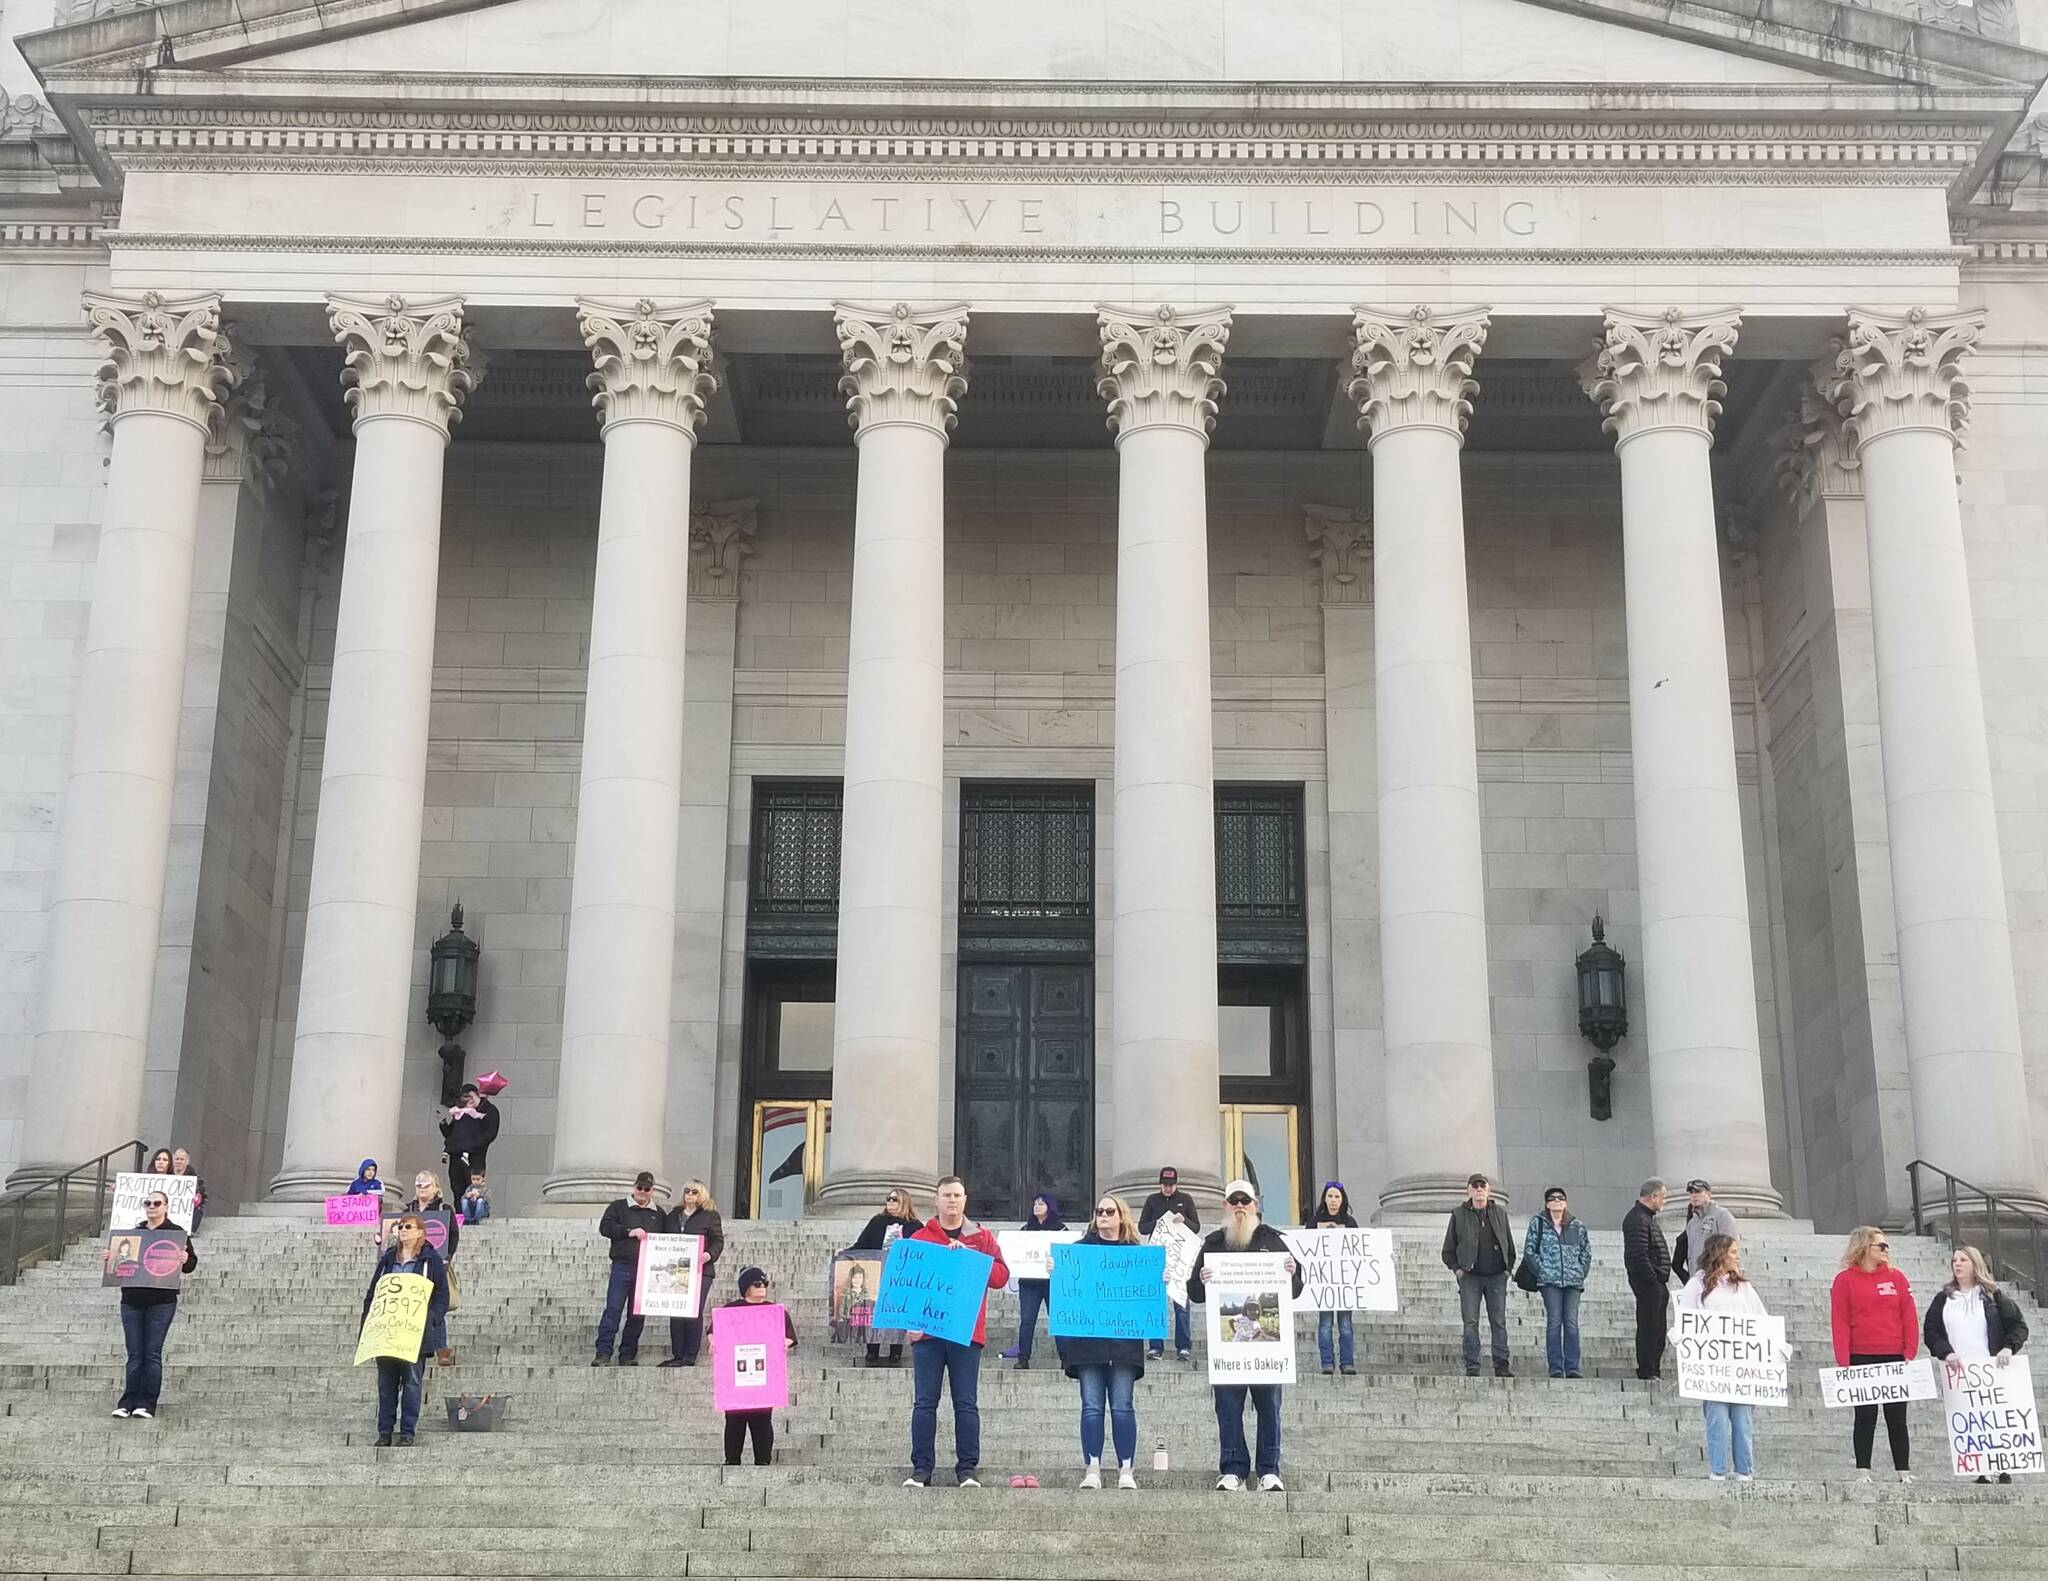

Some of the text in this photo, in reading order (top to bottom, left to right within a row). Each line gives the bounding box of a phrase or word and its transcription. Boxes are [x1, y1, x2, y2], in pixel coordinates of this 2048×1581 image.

[528, 193, 1538, 236] LEGISLATIVE BUILDING
[119, 1176, 195, 1196] PROTECT OUR
[329, 1197, 372, 1209] I STAND
[329, 1212, 345, 1223] FOR
[1296, 1233, 1373, 1257] WE ARE
[1060, 1248, 1080, 1280] My
[1100, 1251, 1160, 1278] daughter's
[881, 1291, 909, 1313] loved
[1310, 1286, 1367, 1309] VOICE
[1057, 1309, 1095, 1335] Oakley
[1146, 1311, 1166, 1328] Act
[1682, 1313, 1757, 1336] FIX THE
[1213, 1357, 1289, 1373] Where is Oakley?
[1682, 1361, 1784, 1382] PASS THE OAKLEY
[1836, 1366, 1882, 1381] PROTECT
[1885, 1363, 1904, 1376] THE
[1945, 1362, 1994, 1390] PASS
[1684, 1378, 1731, 1395] CARLSON
[1735, 1383, 1752, 1397] ACT
[1837, 1385, 1910, 1403] CHILDREN
[1962, 1387, 2008, 1408] THE
[1952, 1408, 2032, 1434] OAKLEY
[1954, 1432, 2035, 1455] CARLSON
[1957, 1452, 2042, 1473] ACT HB1397
